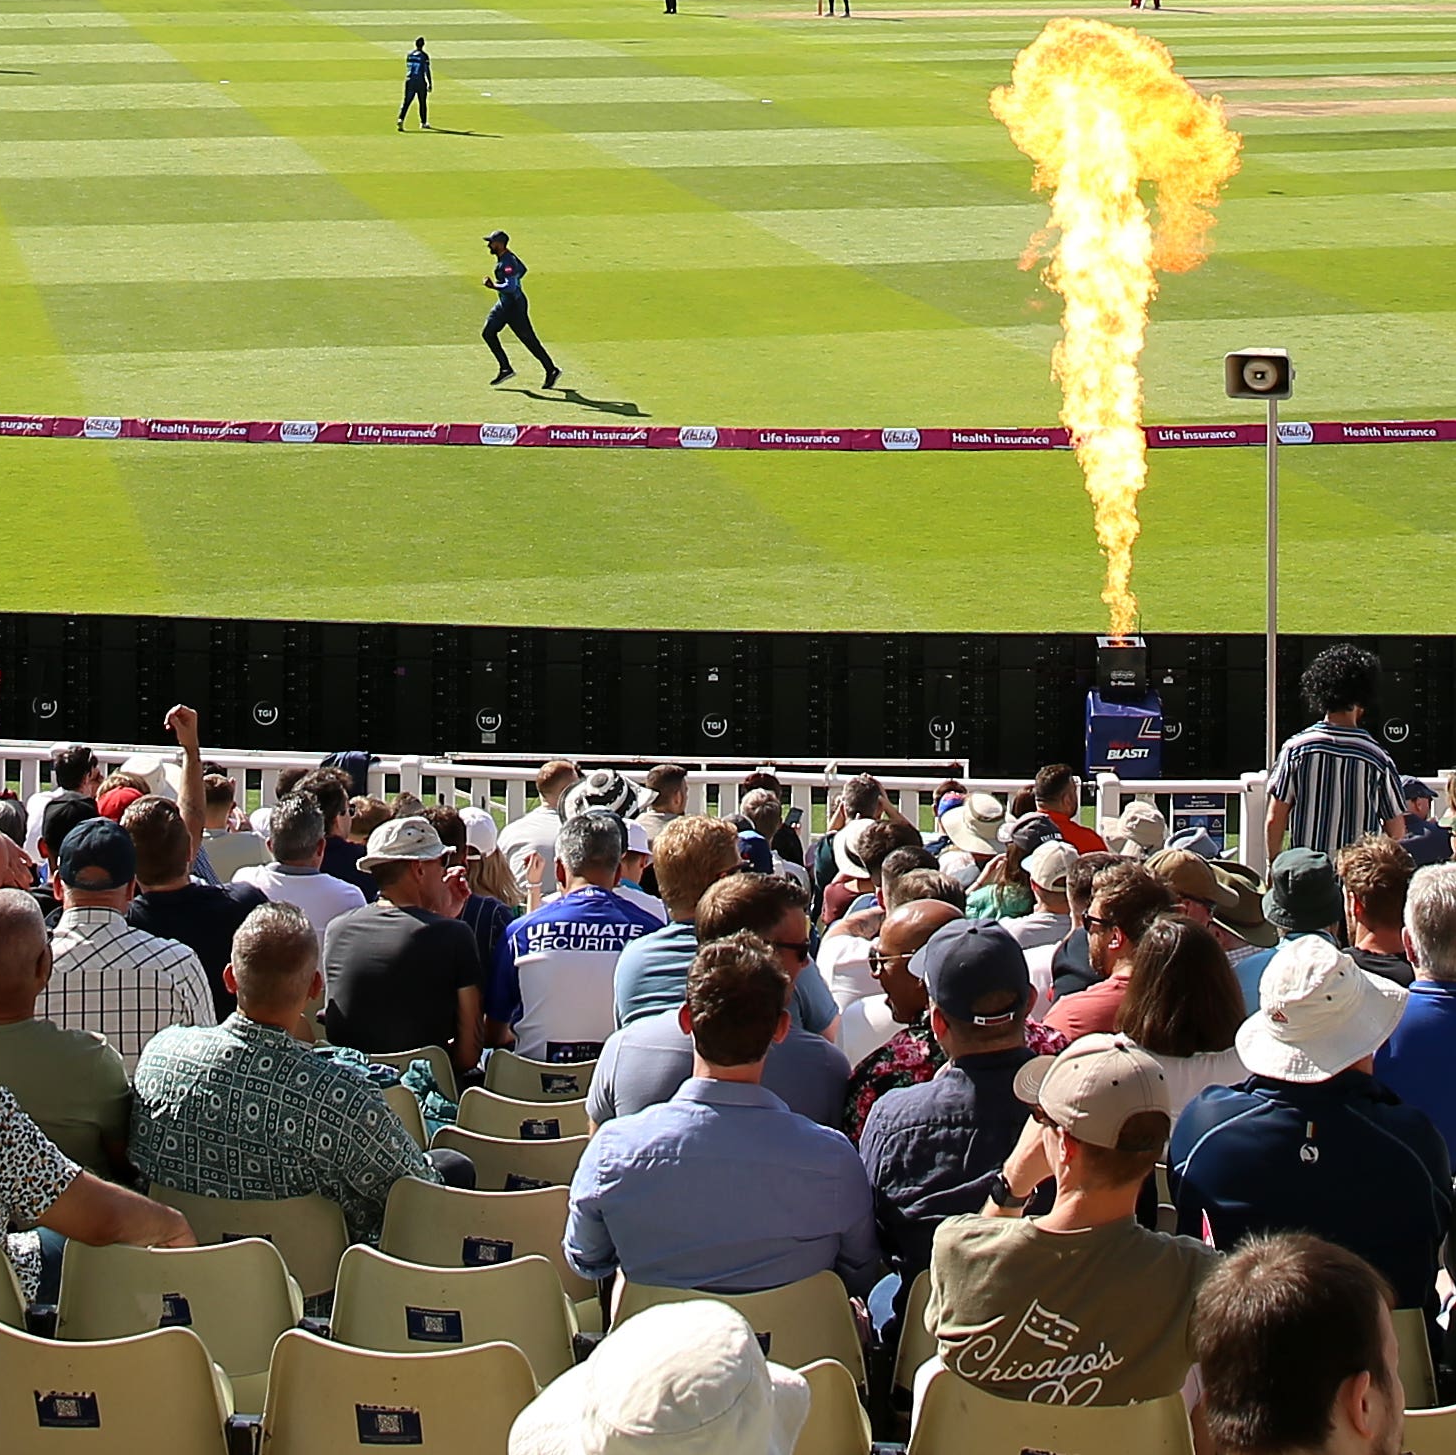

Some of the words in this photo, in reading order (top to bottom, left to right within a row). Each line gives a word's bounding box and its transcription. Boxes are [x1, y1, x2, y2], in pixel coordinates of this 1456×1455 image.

[151, 423, 190, 435] Health
[192, 424, 247, 435] insurance
[358, 426, 379, 438] Life
[382, 428, 437, 439] insurance
[551, 429, 590, 441] Health
[592, 430, 648, 442] insurance
[1158, 429, 1180, 442] Life
[1182, 428, 1236, 441] insurance
[1343, 426, 1382, 438] Health
[1383, 426, 1437, 438] insurance
[760, 432, 782, 444] Life
[784, 433, 840, 445] insurance
[952, 432, 991, 444] Health
[994, 433, 1050, 445] insurance
[258, 709, 272, 718] TGI
[706, 722, 721, 730] TGI
[1388, 727, 1403, 735] TGI
[1106, 748, 1149, 761] BLAST!
[527, 921, 644, 940] ULTIMATE
[528, 936, 632, 954] SECURITY
[956, 1333, 1124, 1383] Chicago's
